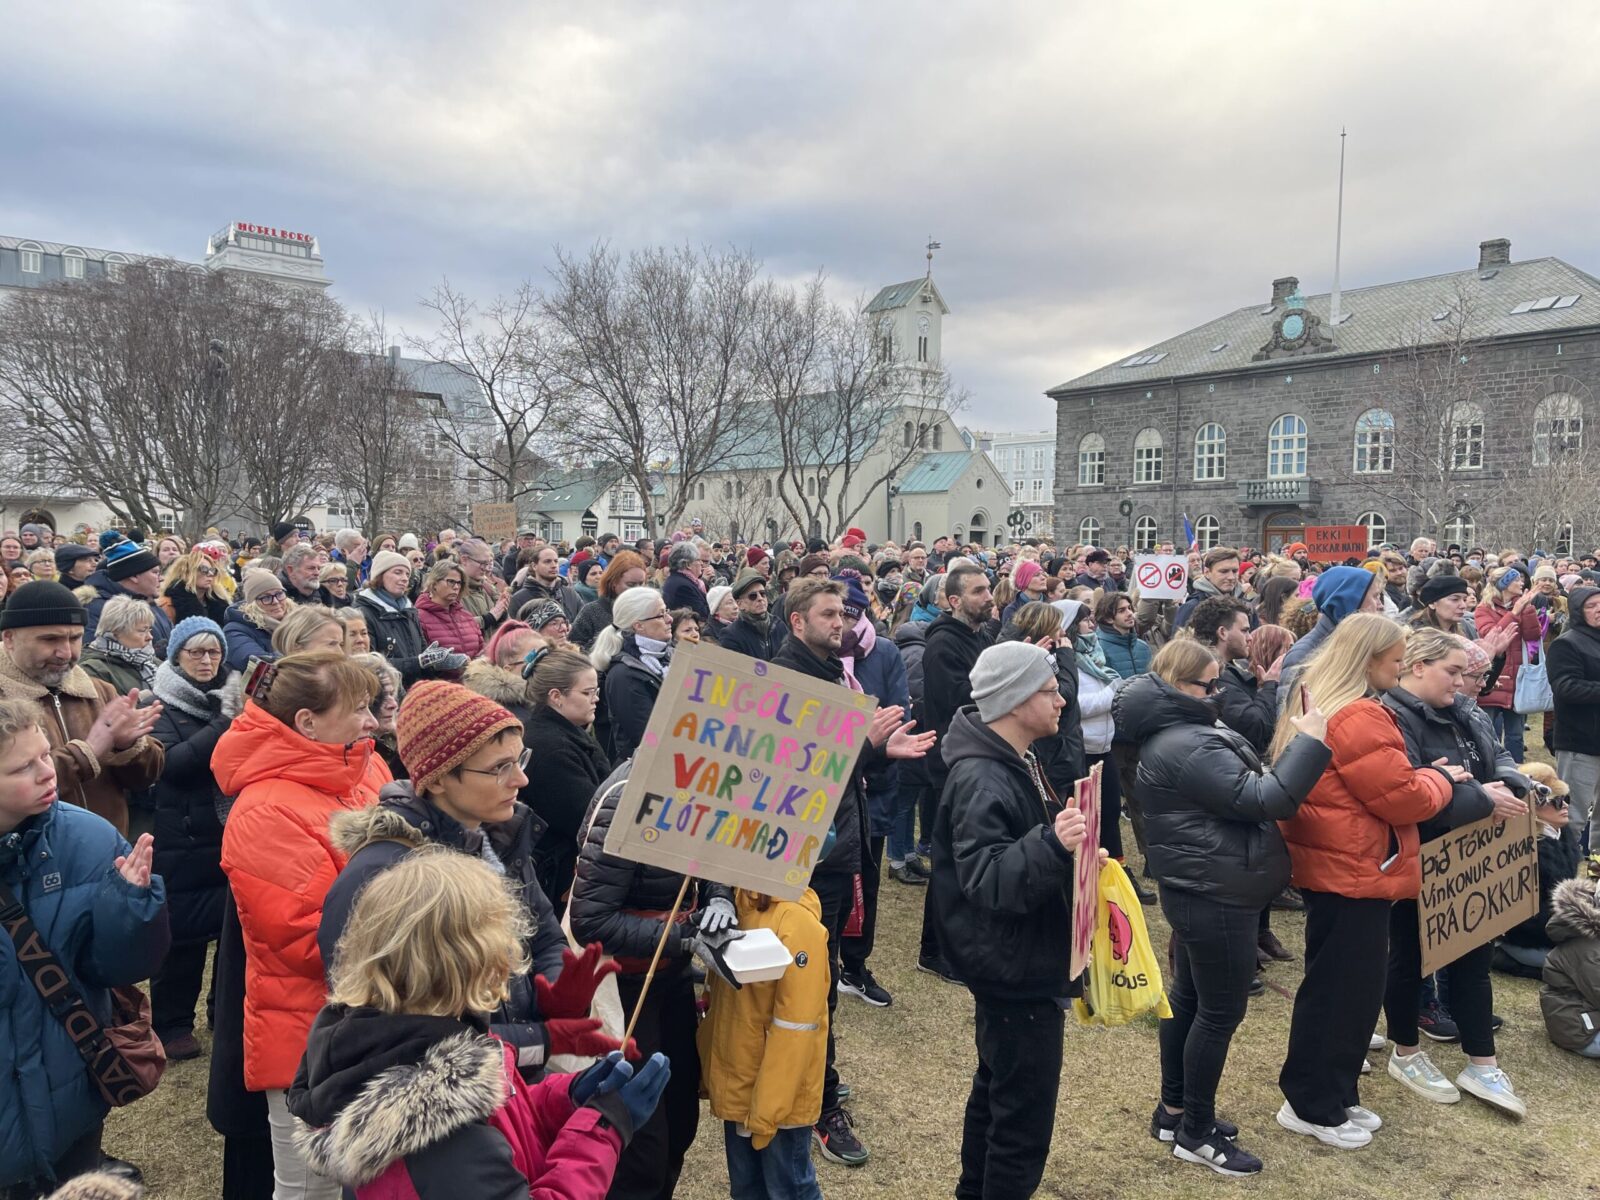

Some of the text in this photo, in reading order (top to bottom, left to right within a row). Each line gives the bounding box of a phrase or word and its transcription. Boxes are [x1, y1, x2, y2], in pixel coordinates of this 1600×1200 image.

[280, 230, 312, 243] BORG
[1308, 544, 1340, 553] OKKAR
[1316, 530, 1340, 540] EKKI
[687, 668, 866, 748] INGÓLFUR
[672, 712, 850, 783] ARNARSON
[674, 753, 828, 824] VAR LÍKA
[635, 792, 820, 868] FLÓTTAMAÐUR
[1496, 835, 1535, 869] OKKAR
[1426, 901, 1459, 950] FRÁ
[1111, 969, 1149, 990] ÓUS
